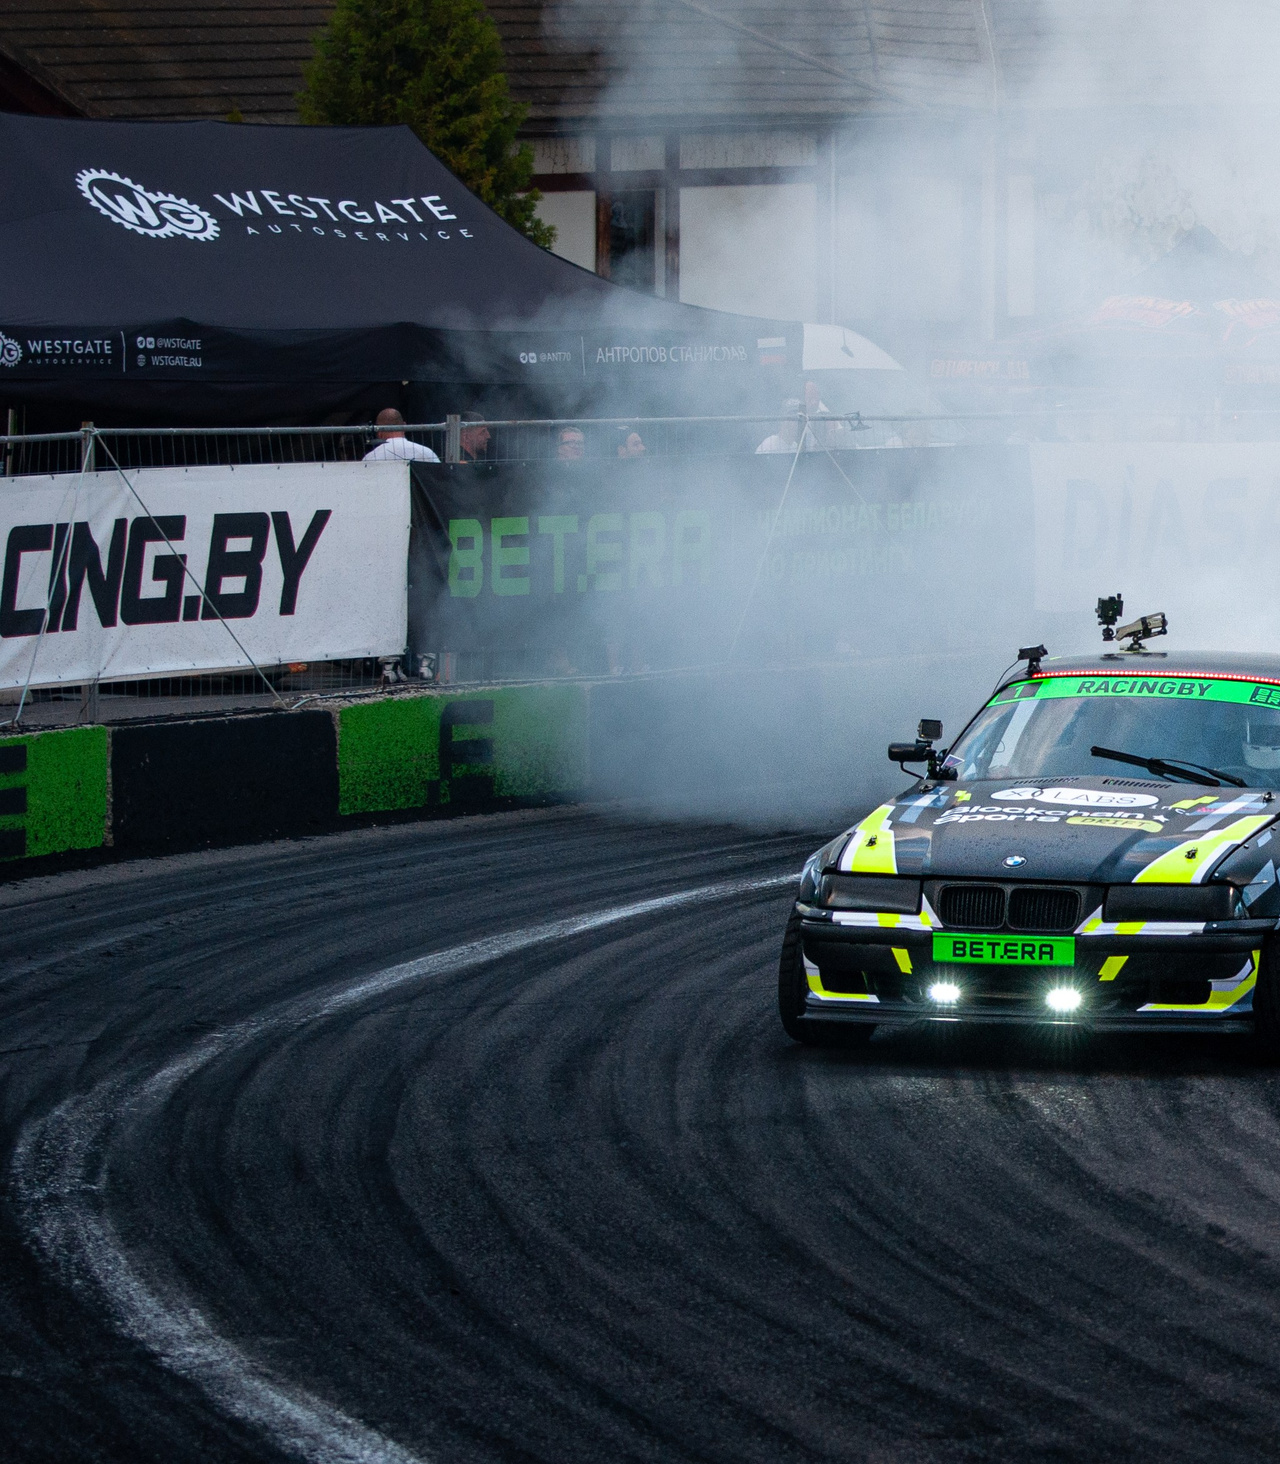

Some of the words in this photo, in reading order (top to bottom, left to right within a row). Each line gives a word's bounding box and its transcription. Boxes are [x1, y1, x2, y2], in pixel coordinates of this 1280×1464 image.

[213, 190, 457, 225] WESTGATE
[246, 223, 474, 242] AUTOSERVICE
[27, 339, 113, 354] WESTGATE
[156, 338, 202, 350] @WSTGATE
[596, 347, 667, 364] АНТРОПОВ
[1013, 685, 1024, 699] 1
[1076, 679, 1214, 697] RACINGBY
[1055, 790, 1138, 805] LABS
[943, 805, 1146, 819] Blockchain
[933, 813, 1061, 825] Sports
[1081, 817, 1148, 828] DRIFT
